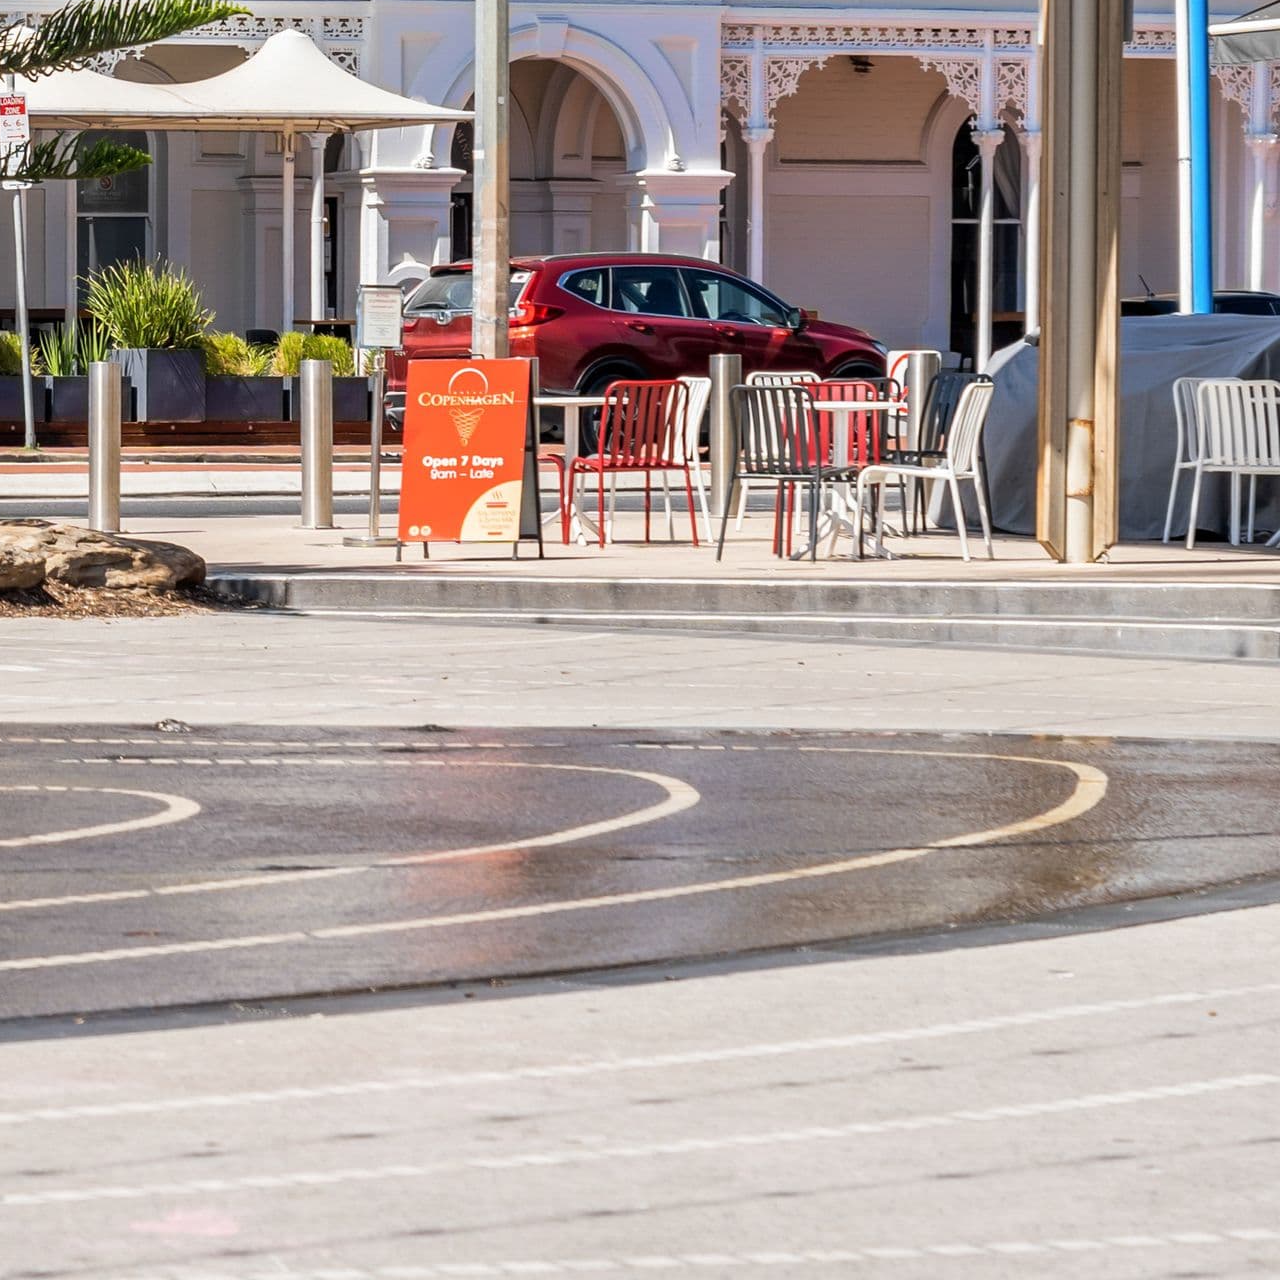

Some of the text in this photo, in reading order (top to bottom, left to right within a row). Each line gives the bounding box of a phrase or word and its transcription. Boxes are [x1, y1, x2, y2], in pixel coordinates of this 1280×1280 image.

[0, 97, 25, 106] LOADING
[4, 106, 22, 115] ZONE
[422, 456, 504, 469] Open 7 Days
[430, 469, 457, 480] 9am
[469, 469, 494, 480] Late
